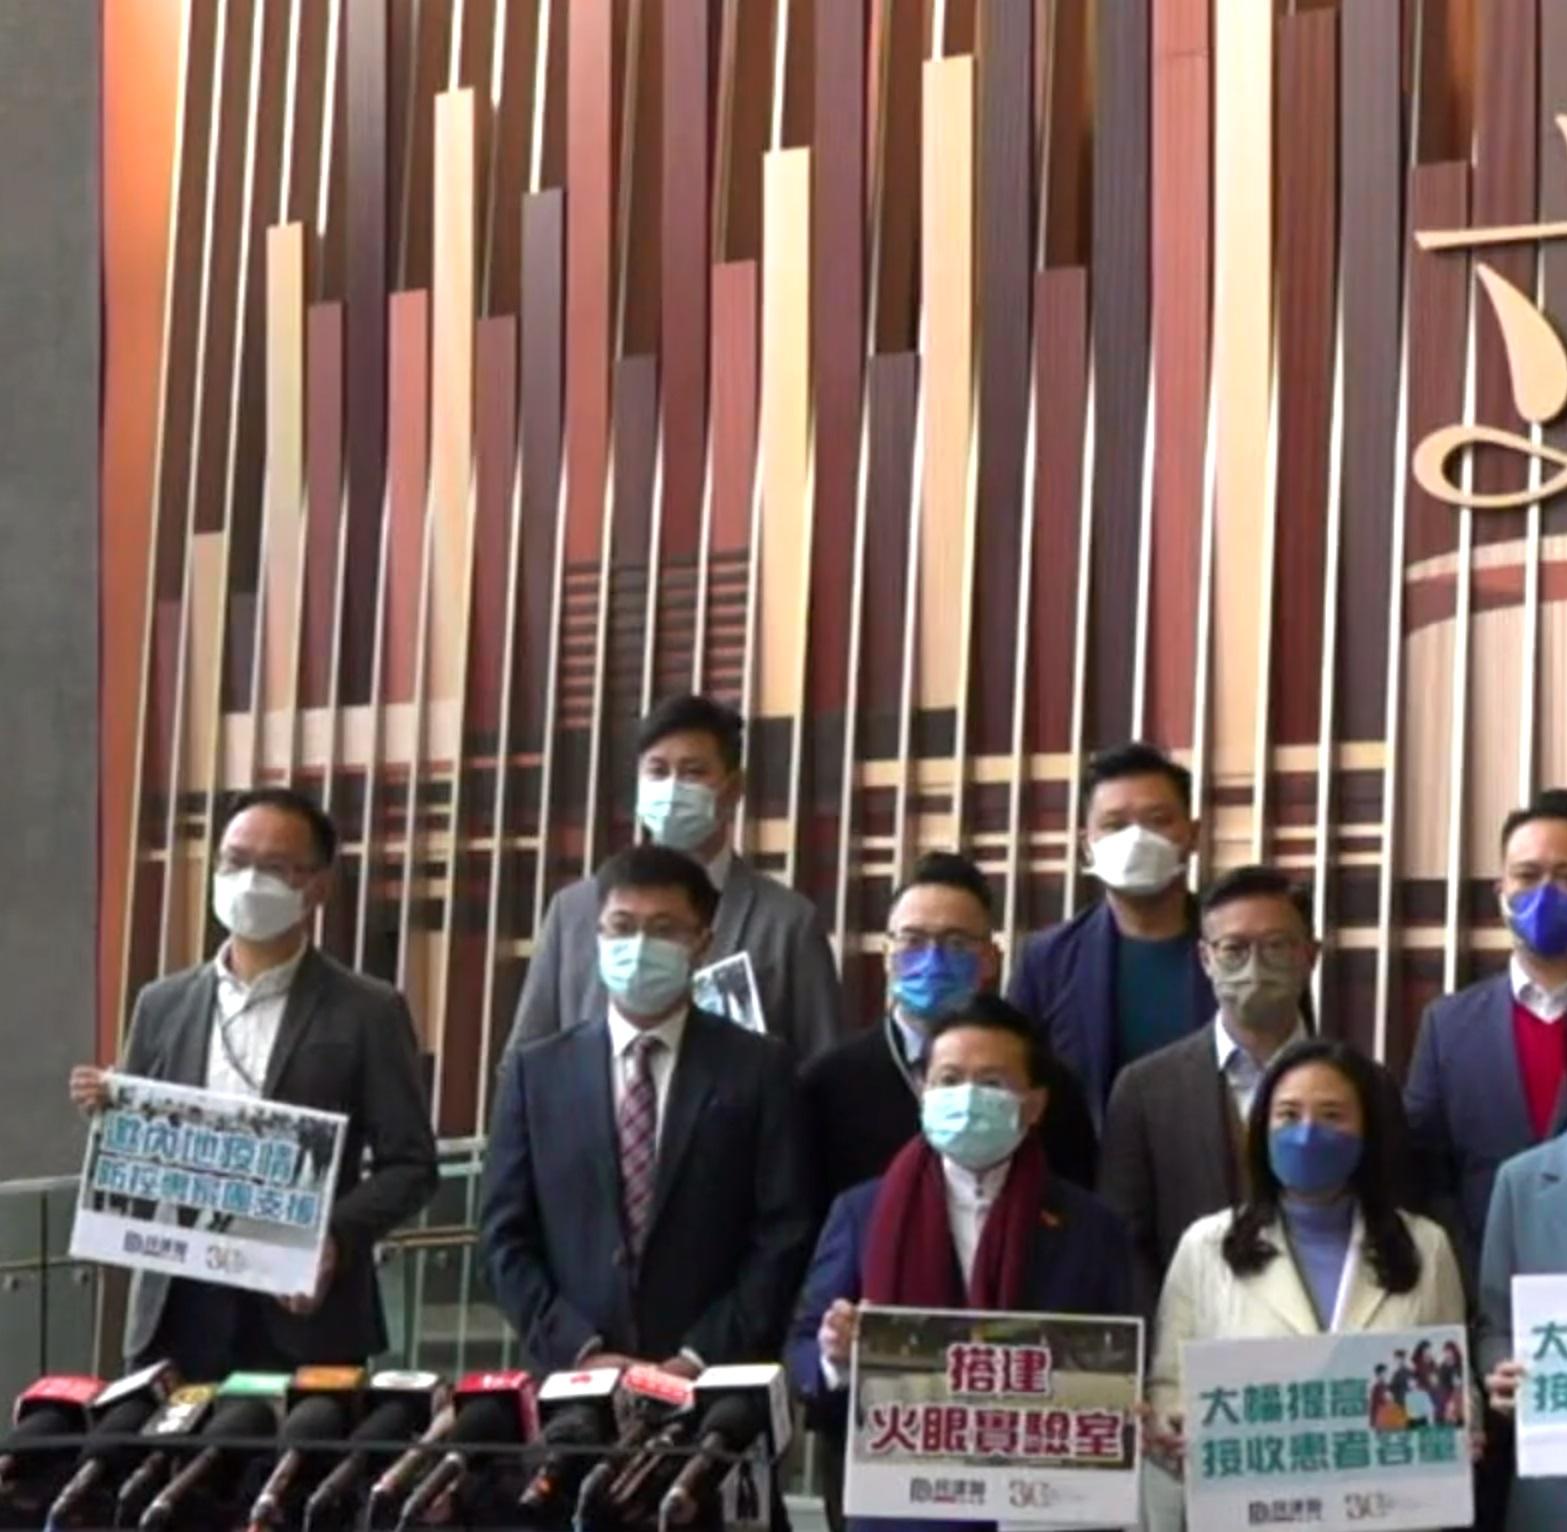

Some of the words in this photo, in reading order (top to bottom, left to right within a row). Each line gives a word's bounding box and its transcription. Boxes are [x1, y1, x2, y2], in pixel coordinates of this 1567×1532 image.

[950, 1346, 1048, 1393] 搭建
[1200, 1378, 1369, 1427] 大幅提高
[871, 1405, 1121, 1457] 火眼實驗室
[1203, 1425, 1456, 1478] 接收患者容量
